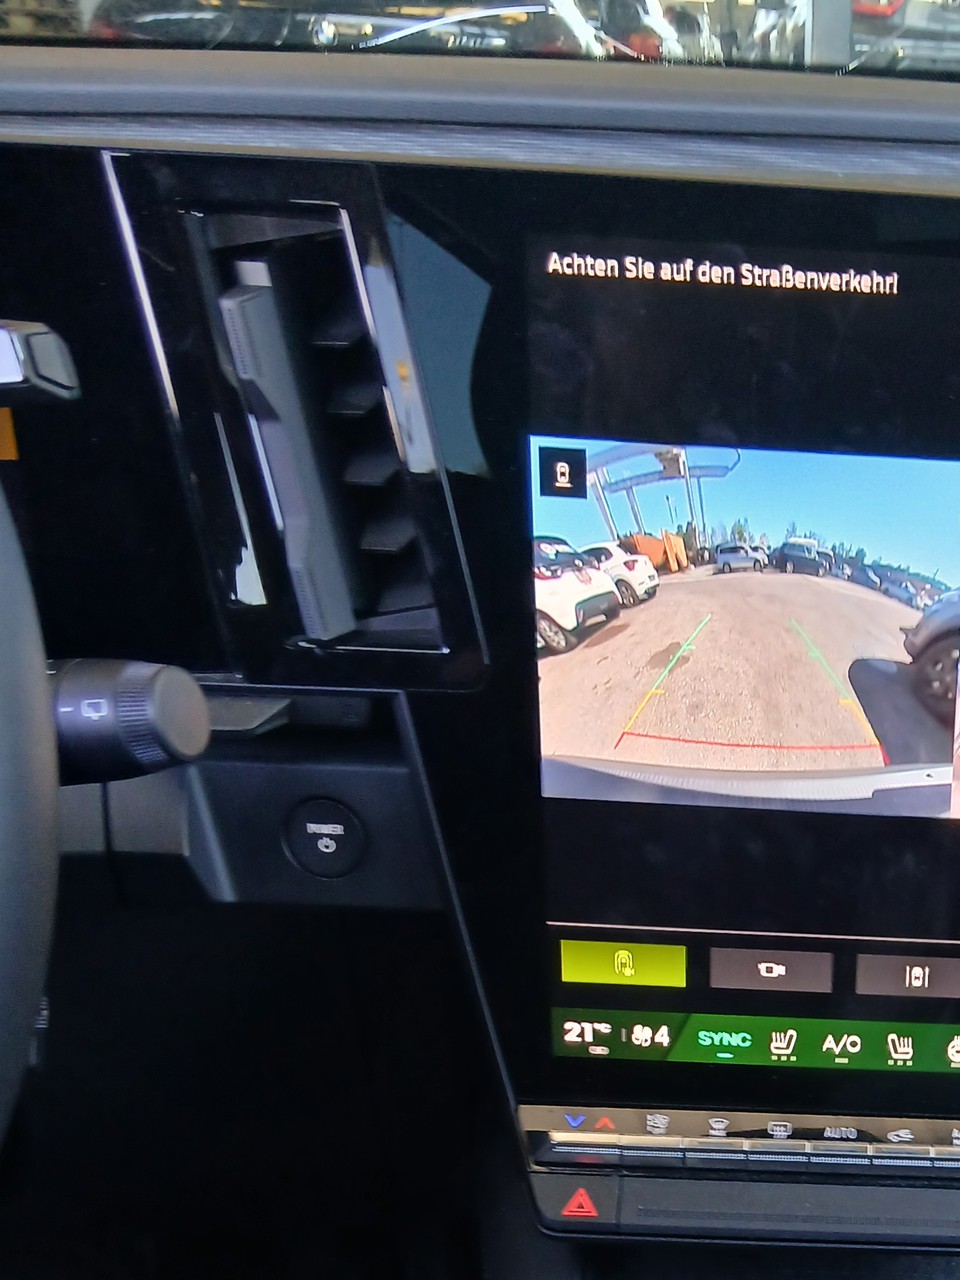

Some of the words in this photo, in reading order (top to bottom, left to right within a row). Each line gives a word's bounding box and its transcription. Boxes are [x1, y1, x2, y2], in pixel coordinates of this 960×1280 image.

[548, 251, 619, 278] Achten
[625, 254, 655, 280] Sie
[660, 257, 694, 282] auf
[698, 260, 735, 285] den
[697, 1030, 753, 1048] SYNC
[823, 1126, 858, 1139] AUTO
